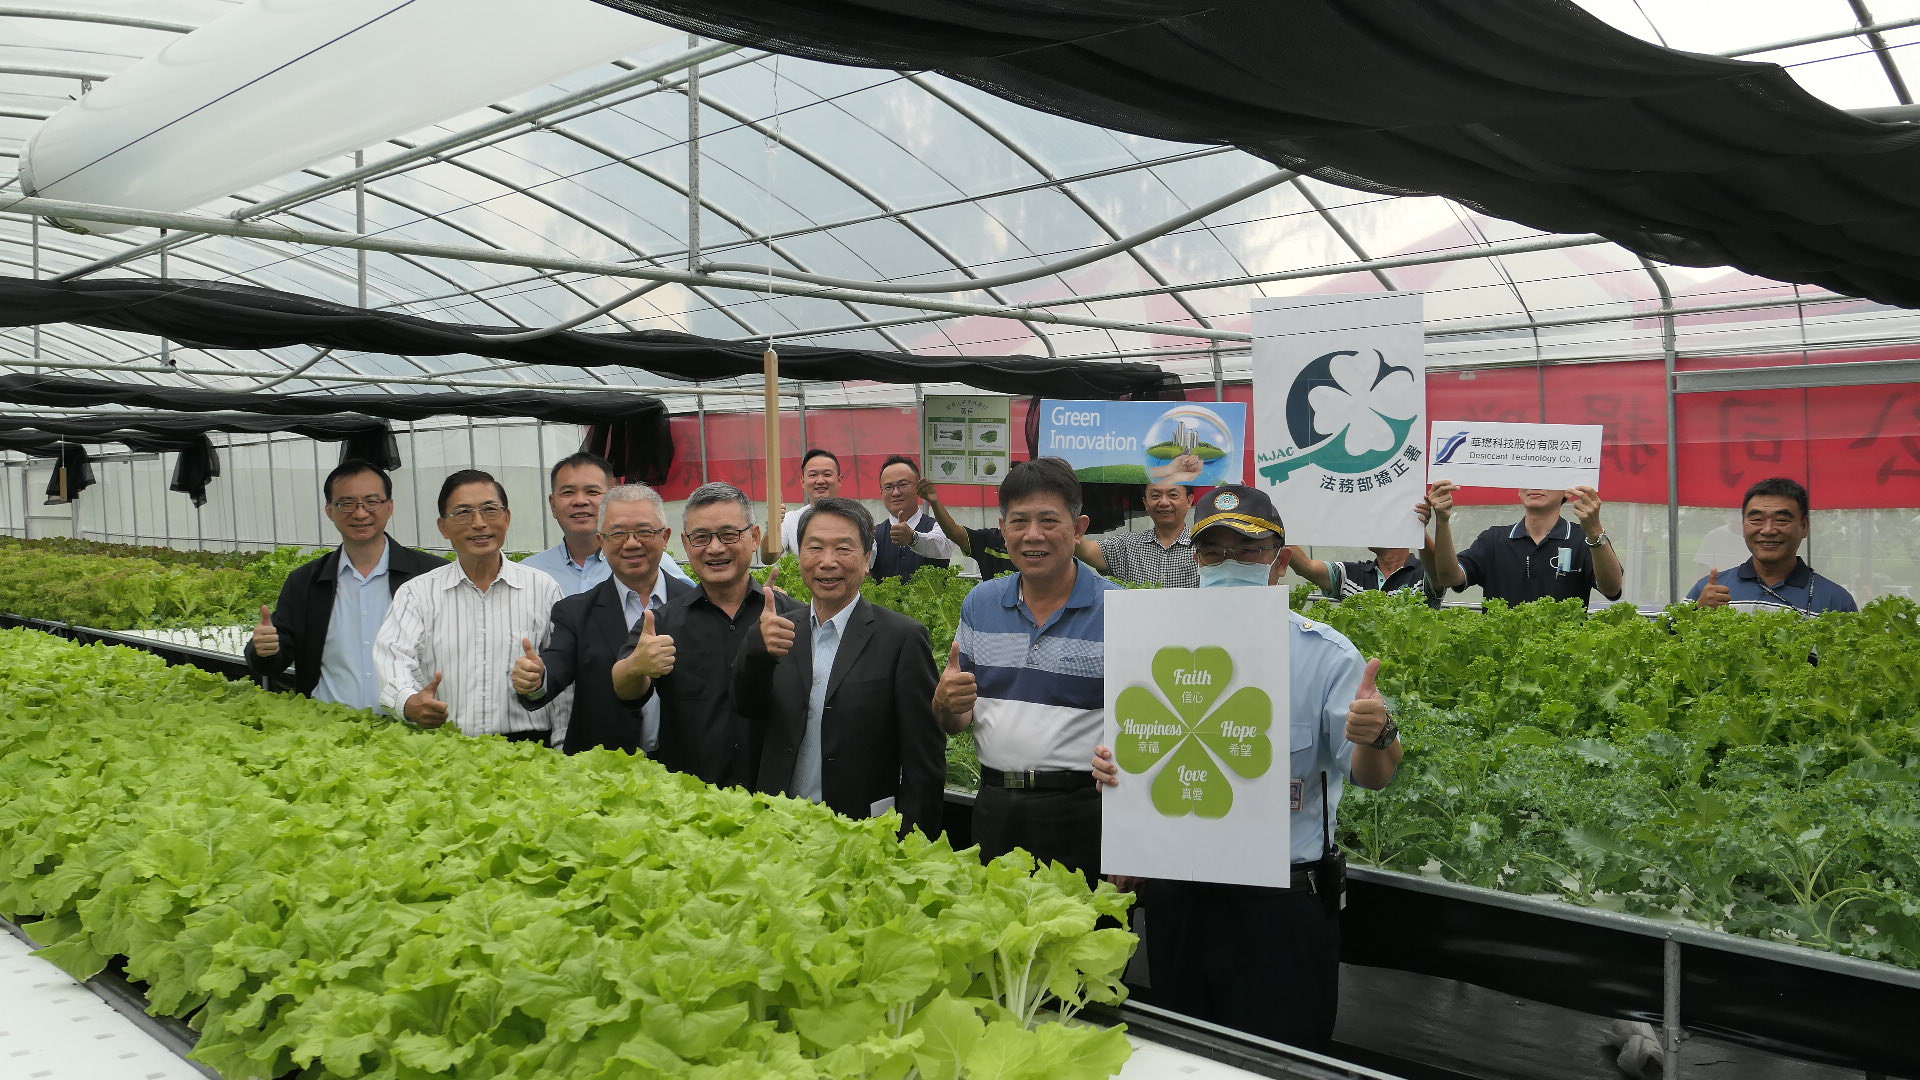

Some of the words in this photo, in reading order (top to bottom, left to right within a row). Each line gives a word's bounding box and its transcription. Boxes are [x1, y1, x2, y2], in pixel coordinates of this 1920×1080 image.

[1051, 407, 1100, 427] Green
[1050, 430, 1137, 451] Innovation
[1258, 446, 1294, 463] MJAC
[1512, 454, 1556, 463] Technology
[1578, 455, 1594, 464] Ltd.
[1320, 444, 1423, 493] 法務部矯正署
[1173, 669, 1212, 686] Faith
[1181, 691, 1203, 704] 信心
[1123, 718, 1183, 740] Happiness
[1220, 720, 1257, 742] Hope
[1137, 741, 1160, 754] 幸福
[1228, 744, 1252, 758] 希望
[1177, 764, 1208, 786] Love
[1181, 787, 1204, 801] 真愛
